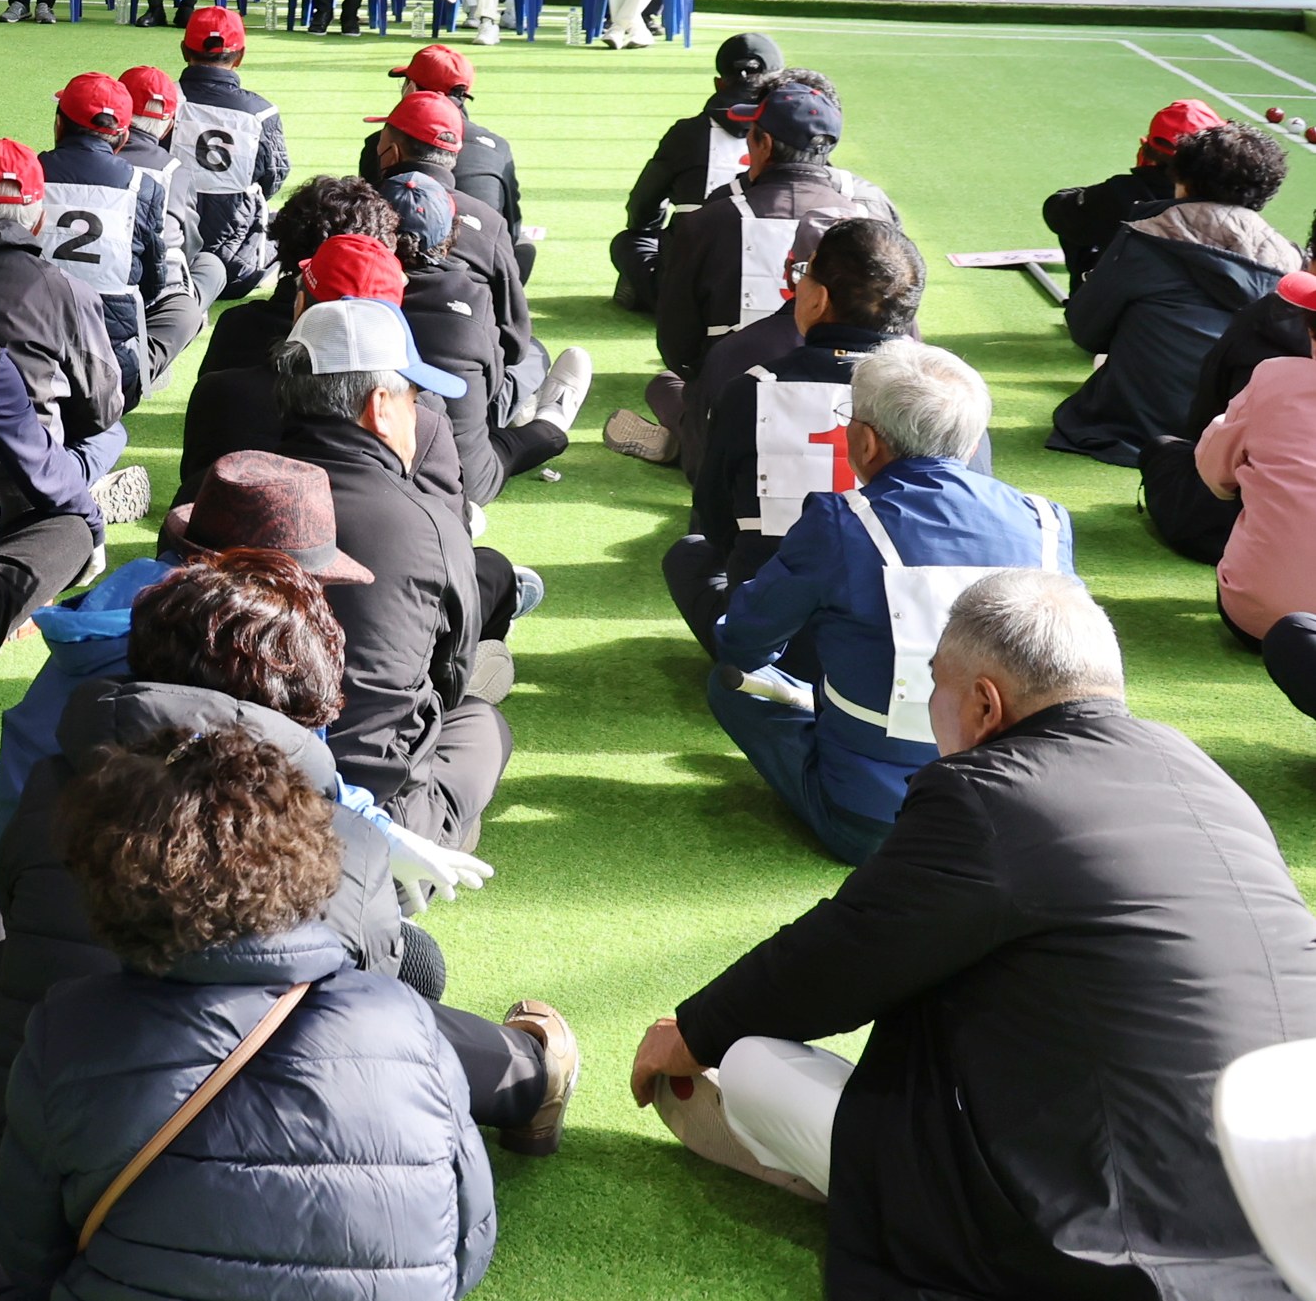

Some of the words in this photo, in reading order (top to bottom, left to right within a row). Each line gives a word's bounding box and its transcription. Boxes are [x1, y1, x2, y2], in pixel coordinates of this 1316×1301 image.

[195, 129, 235, 172] 6
[52, 210, 104, 264] 2
[808, 424, 856, 494] 1
